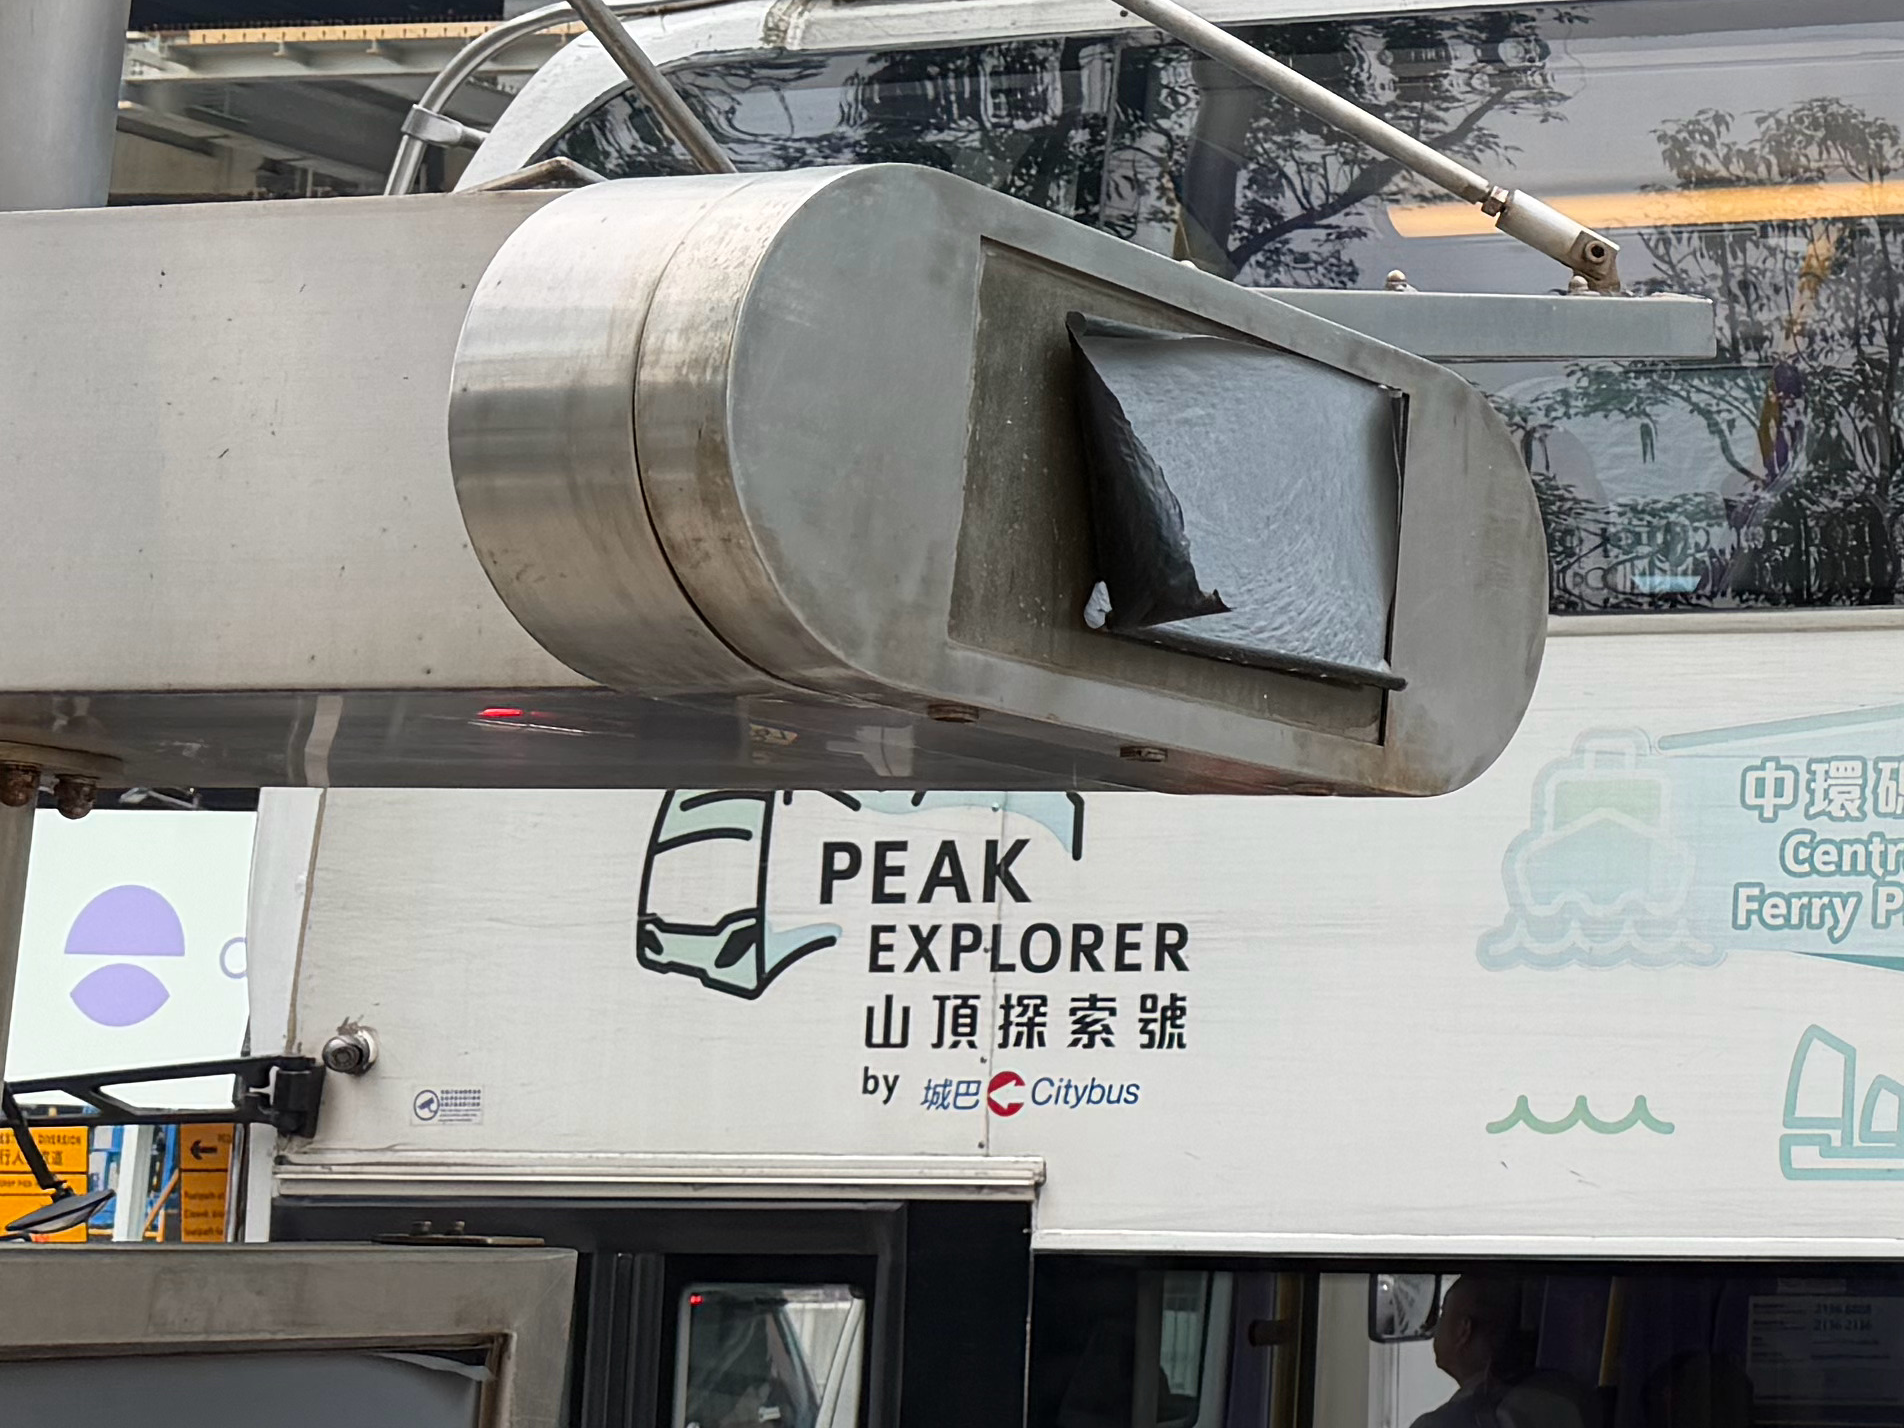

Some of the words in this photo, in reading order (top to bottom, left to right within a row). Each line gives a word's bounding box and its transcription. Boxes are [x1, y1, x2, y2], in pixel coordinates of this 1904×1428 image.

[819, 838, 1032, 905] PEAK
[1732, 882, 1863, 944] Ferry
[868, 922, 1190, 973] EXPLORER
[865, 993, 1188, 1050] 山頂探索號
[861, 1066, 900, 1103] by
[921, 1078, 981, 1111] 城巴
[1032, 1076, 1139, 1108] Citybus
